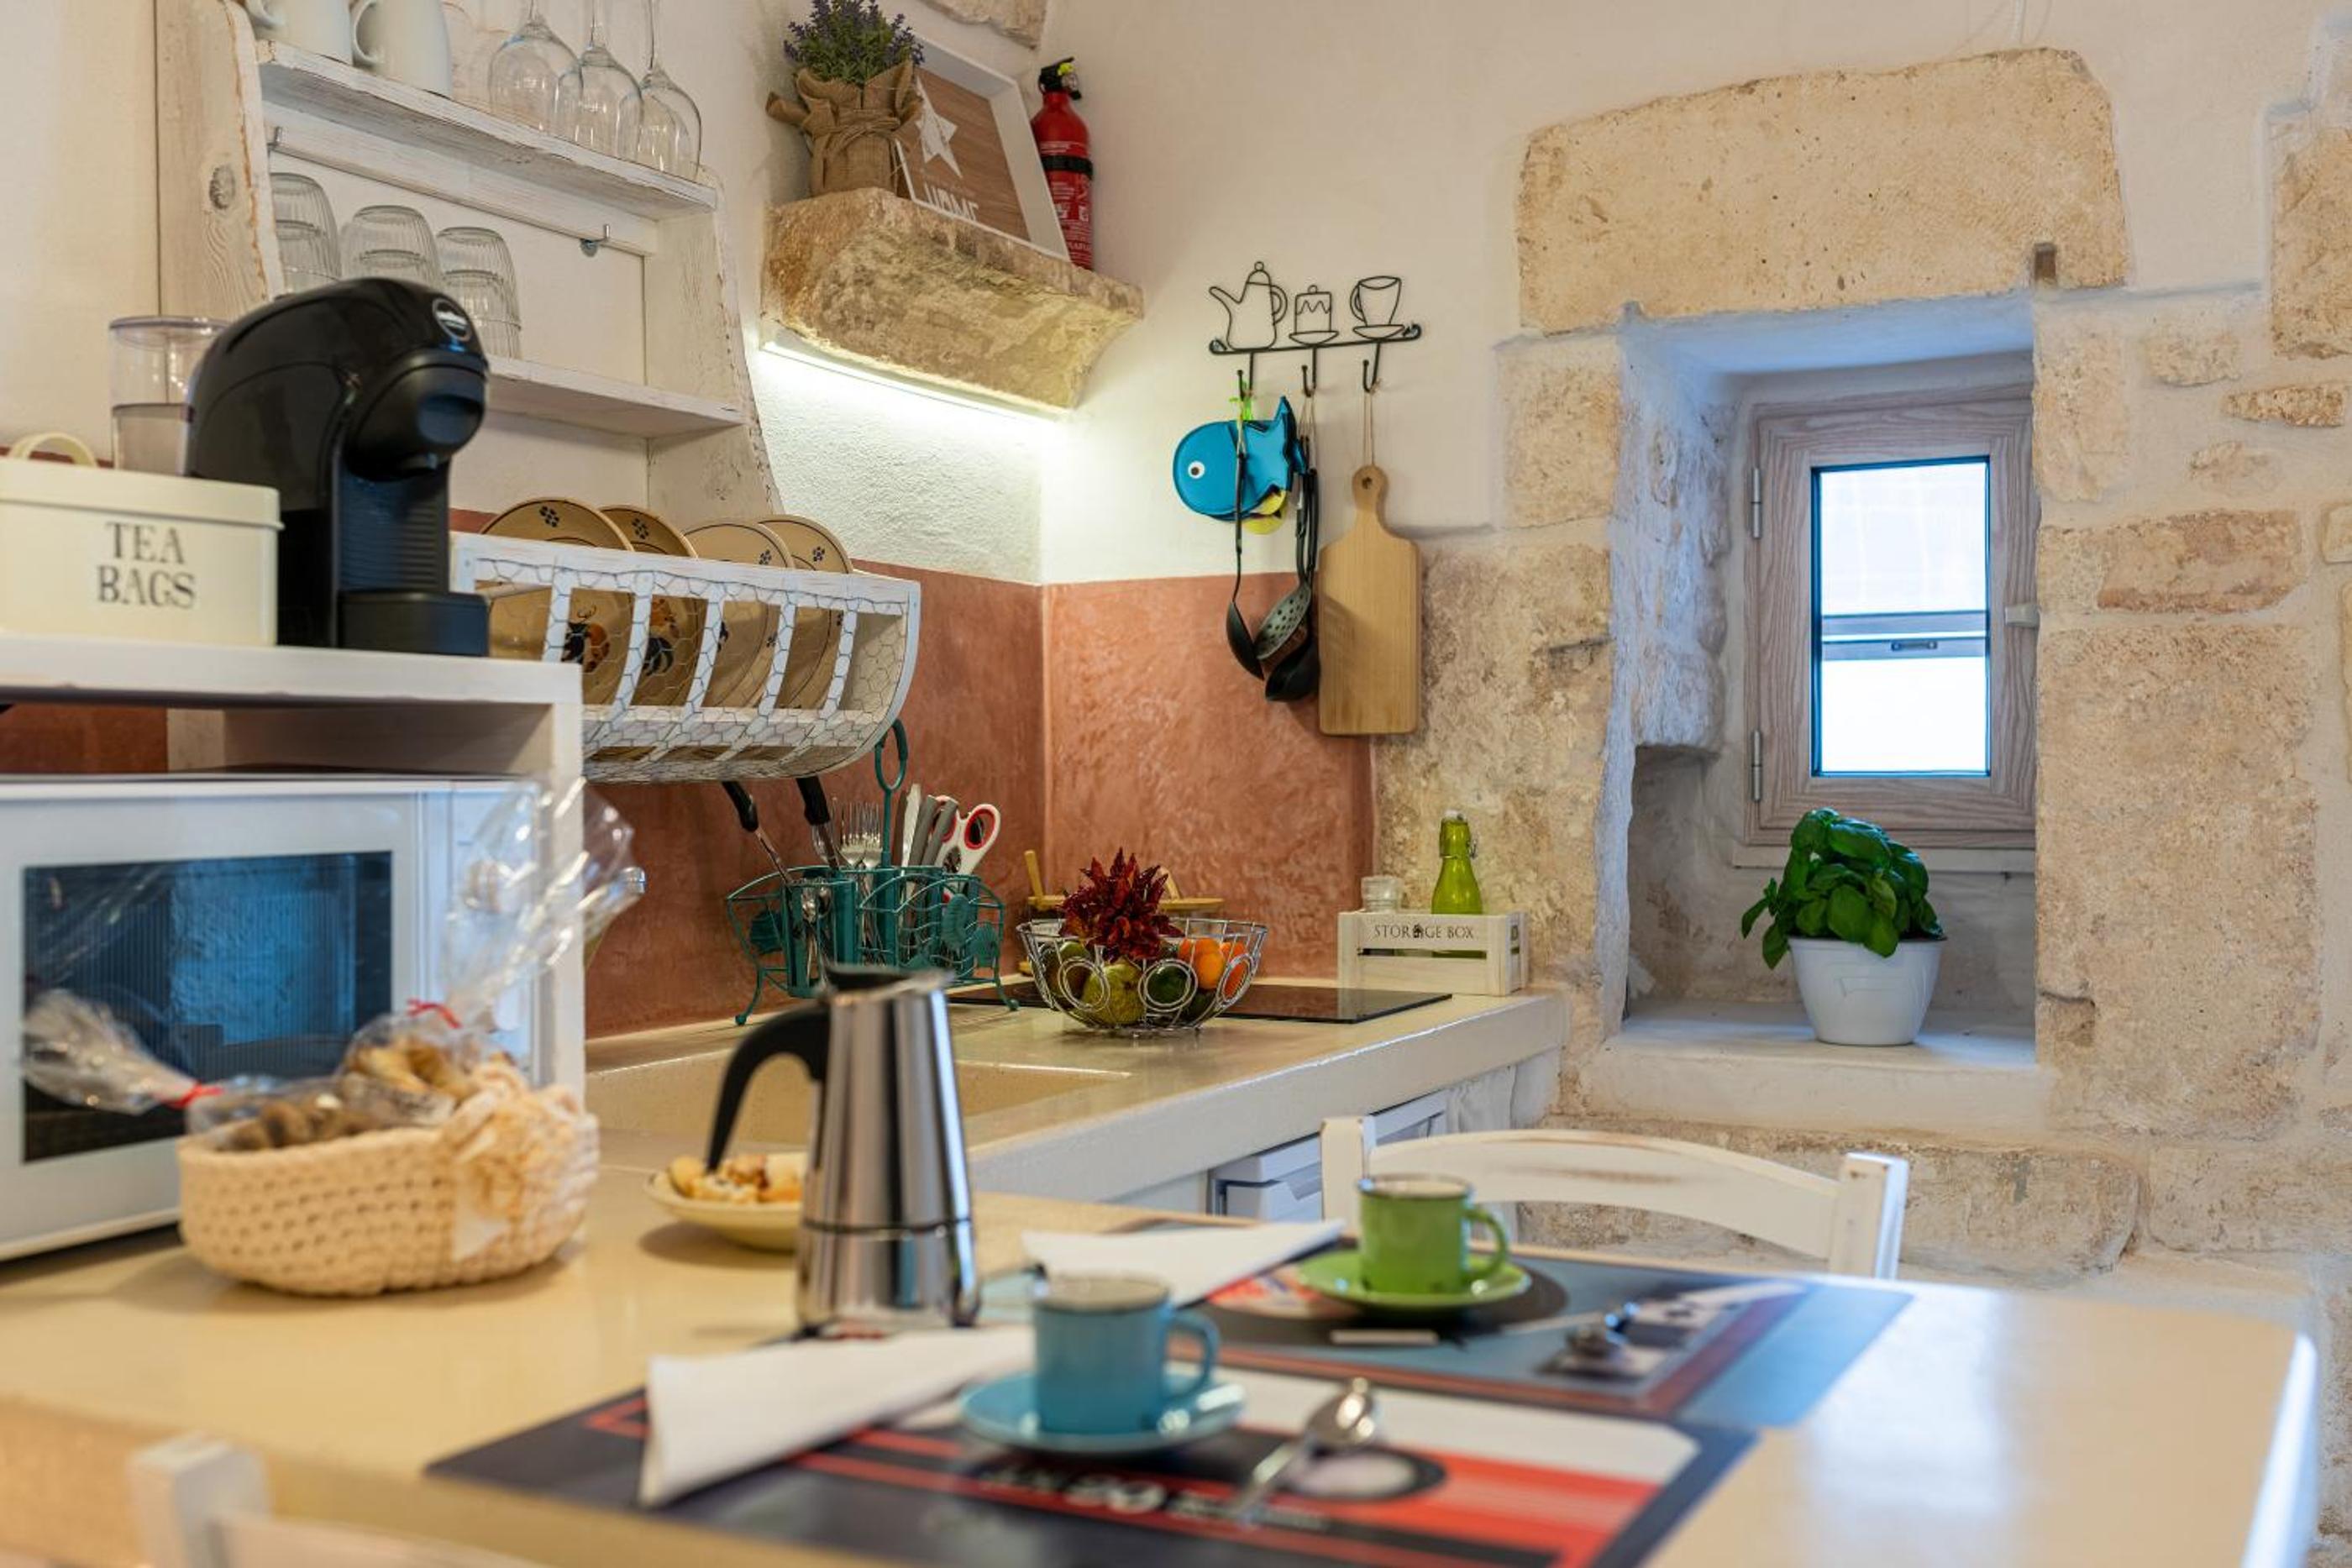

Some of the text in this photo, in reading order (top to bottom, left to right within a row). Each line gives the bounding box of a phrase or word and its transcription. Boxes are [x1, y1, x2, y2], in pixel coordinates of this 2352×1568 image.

[105, 522, 185, 564] TEA
[97, 565, 197, 609] BAGS
[1446, 925, 1474, 939] BOX
